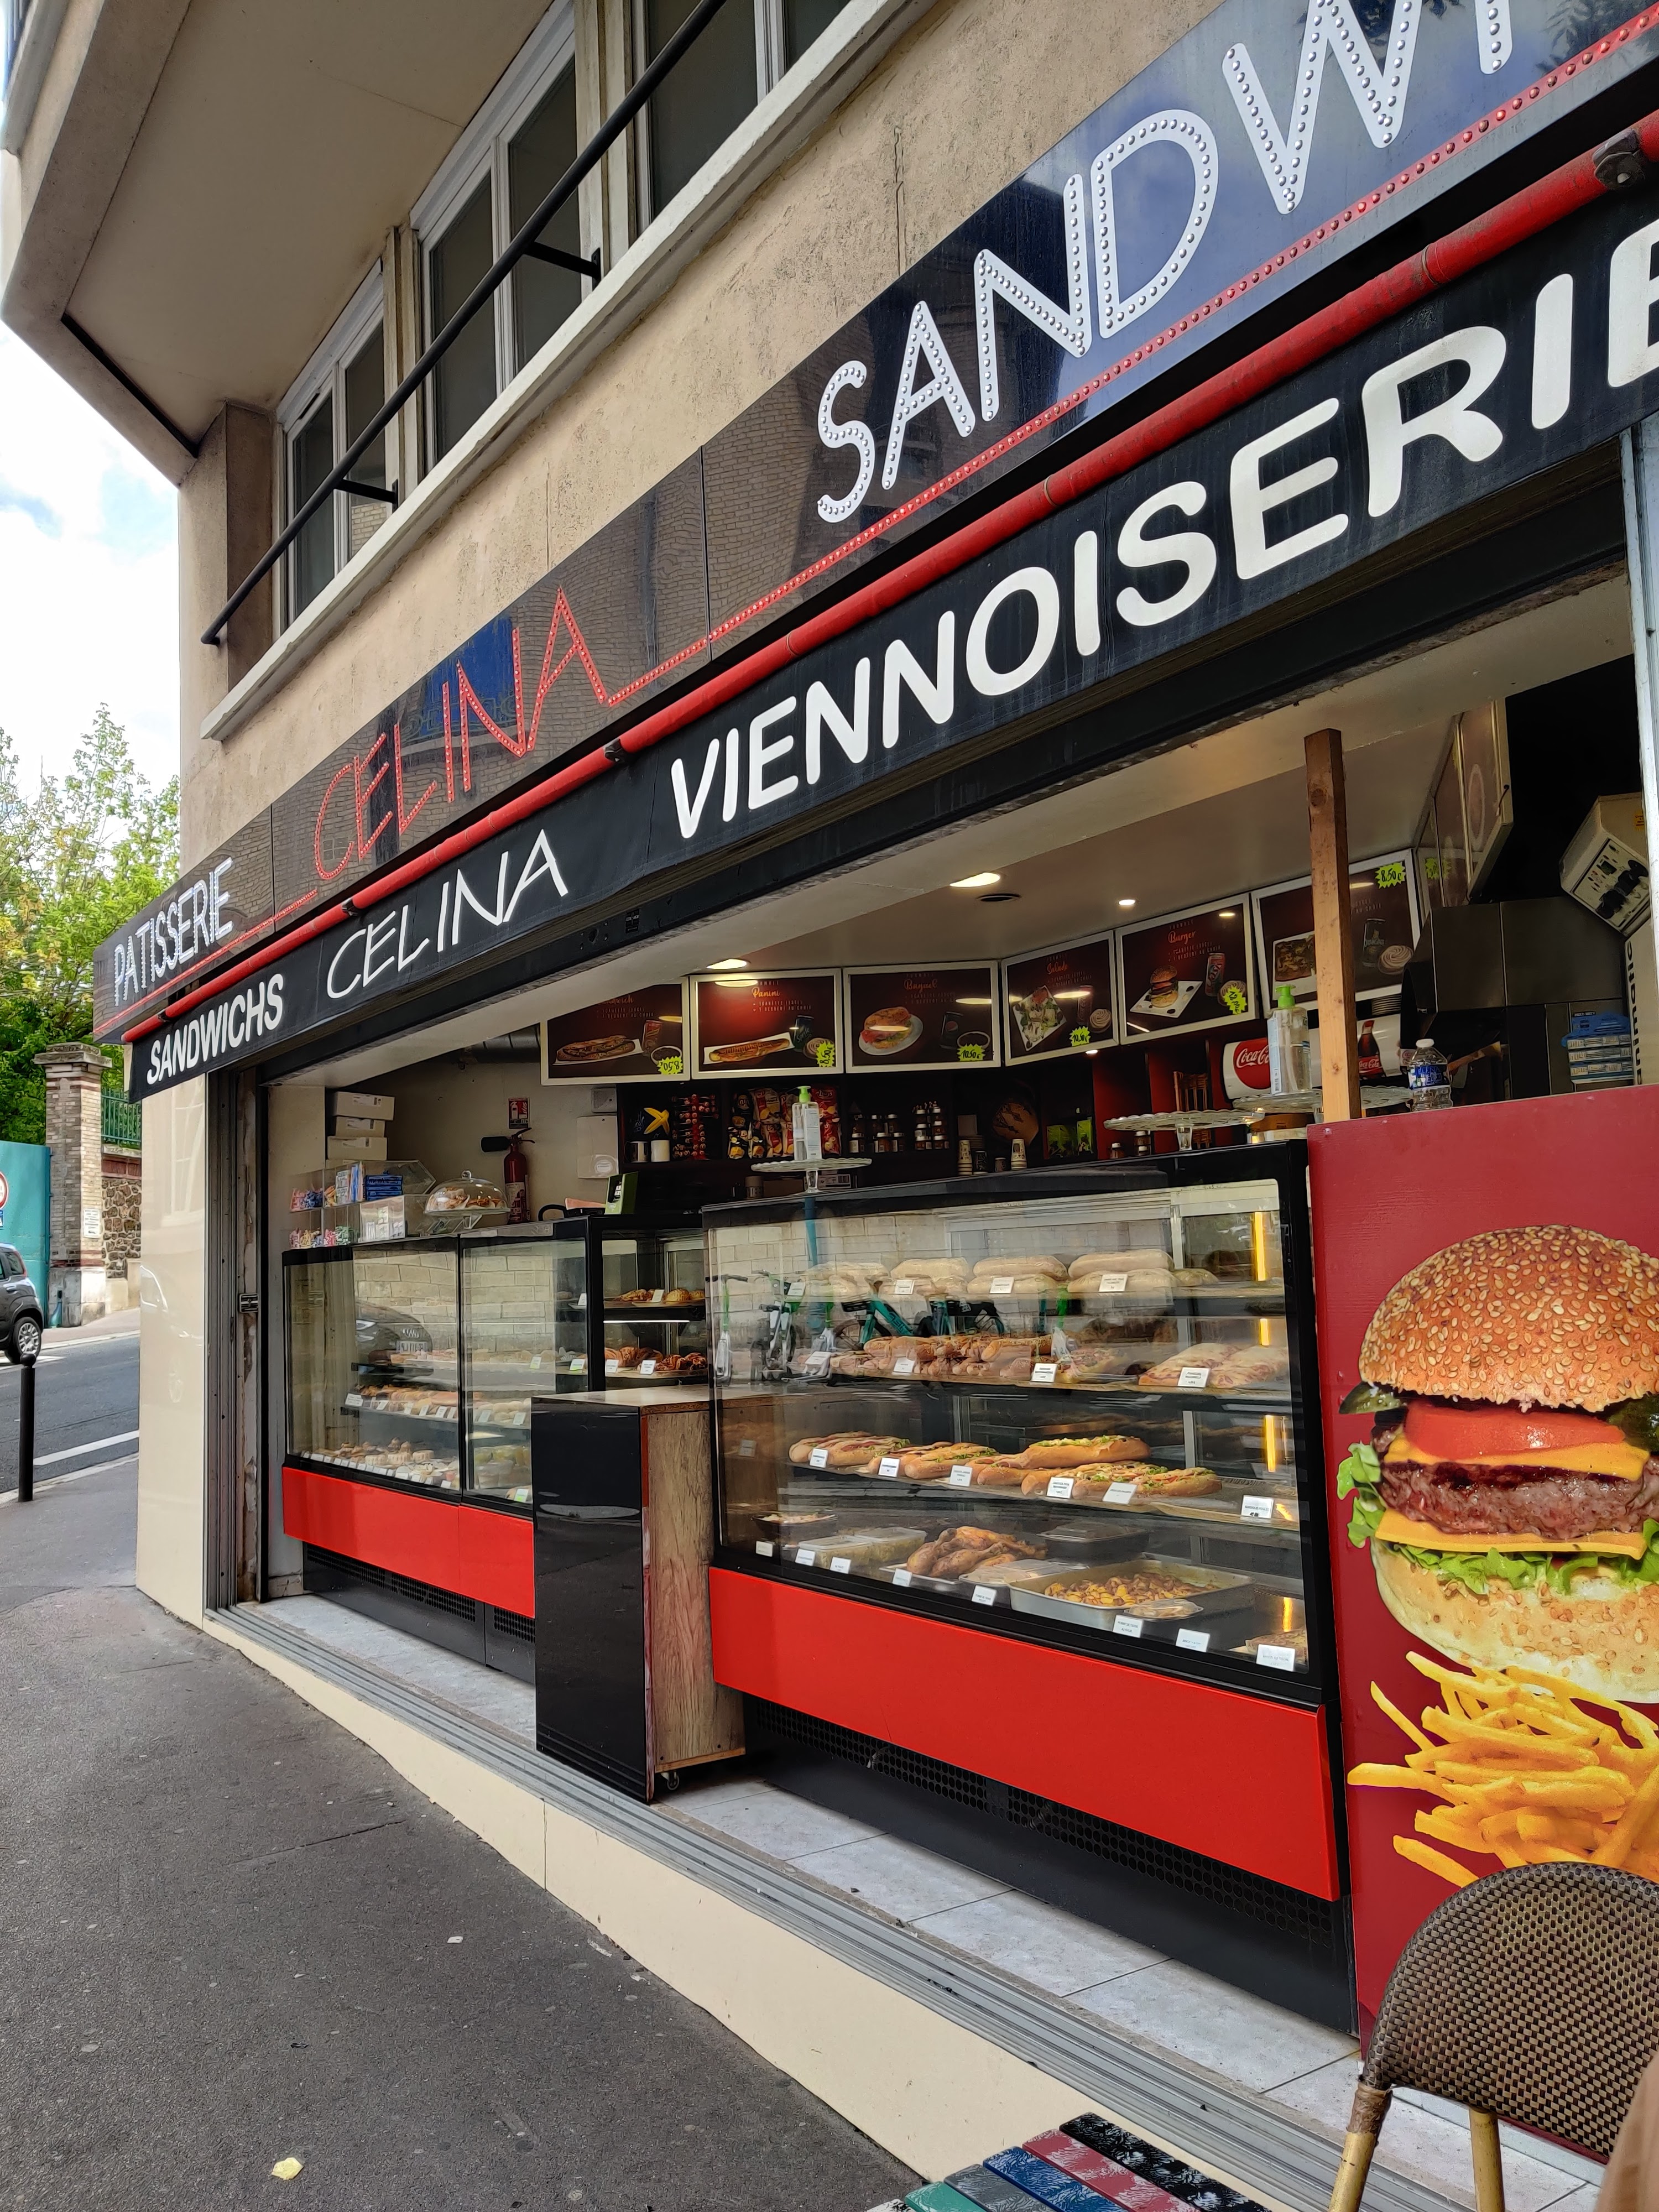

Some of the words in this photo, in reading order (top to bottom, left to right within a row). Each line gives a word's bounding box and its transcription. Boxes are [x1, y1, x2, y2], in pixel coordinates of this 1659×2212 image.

[114, 857, 234, 1008] PATISSERIE
[314, 585, 608, 880] CELINA
[1168, 931, 1196, 945] Burger
[147, 973, 284, 1085] SANDWICHS
[326, 828, 568, 999] CELINA
[752, 987, 780, 998] Panini
[1236, 1045, 1269, 1068] Coca-Co
